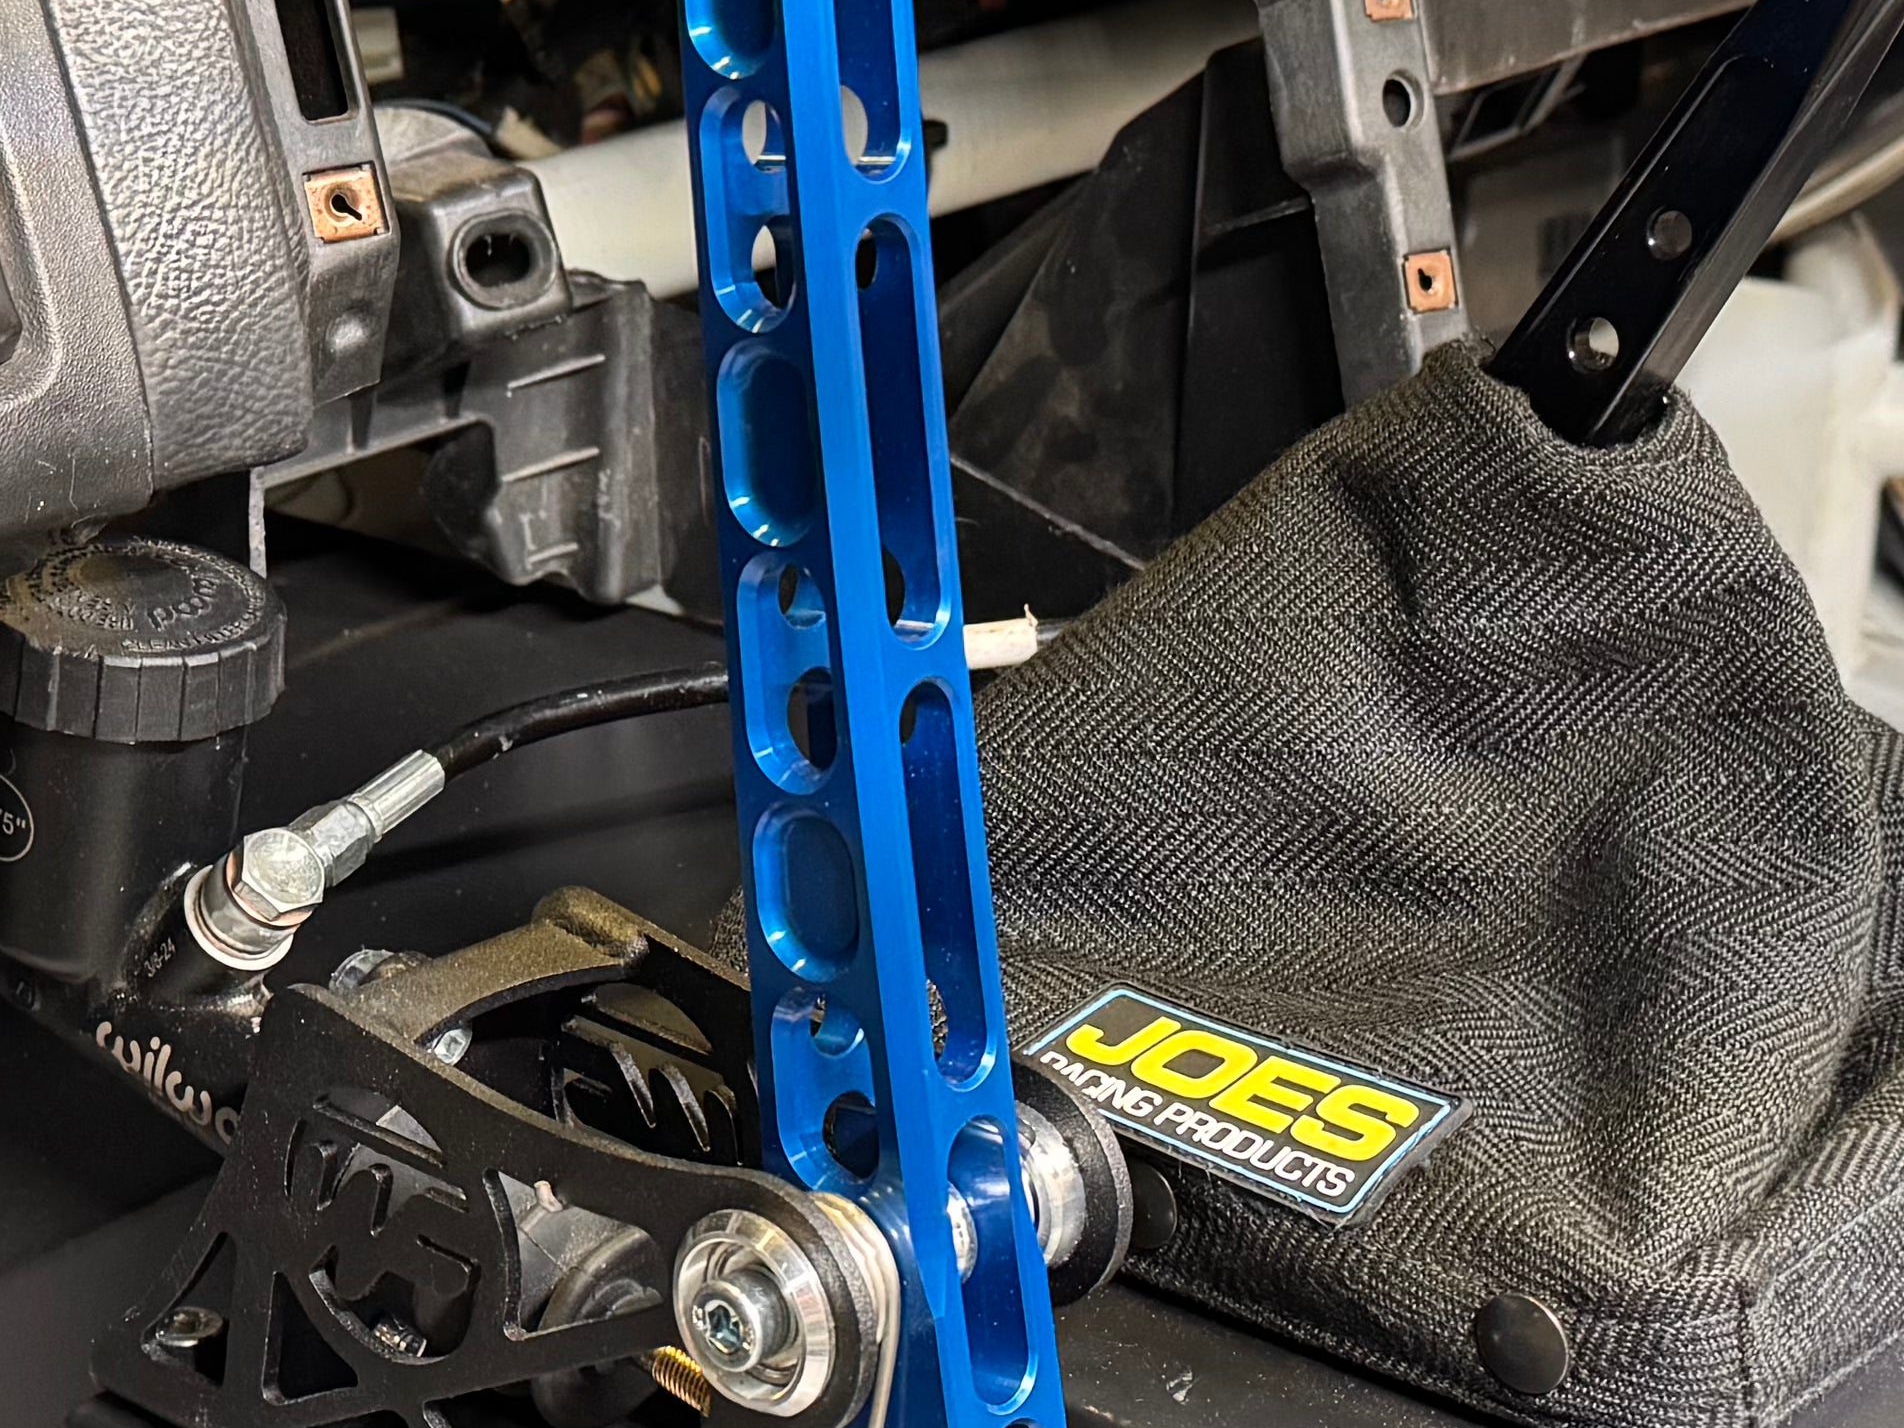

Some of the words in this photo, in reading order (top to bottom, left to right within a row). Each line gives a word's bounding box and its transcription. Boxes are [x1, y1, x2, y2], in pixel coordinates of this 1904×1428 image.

[96, 1021, 241, 1145] wilwo
[1066, 1016, 1421, 1162] JOES
[1153, 1101, 1356, 1197] PRODUCTS
